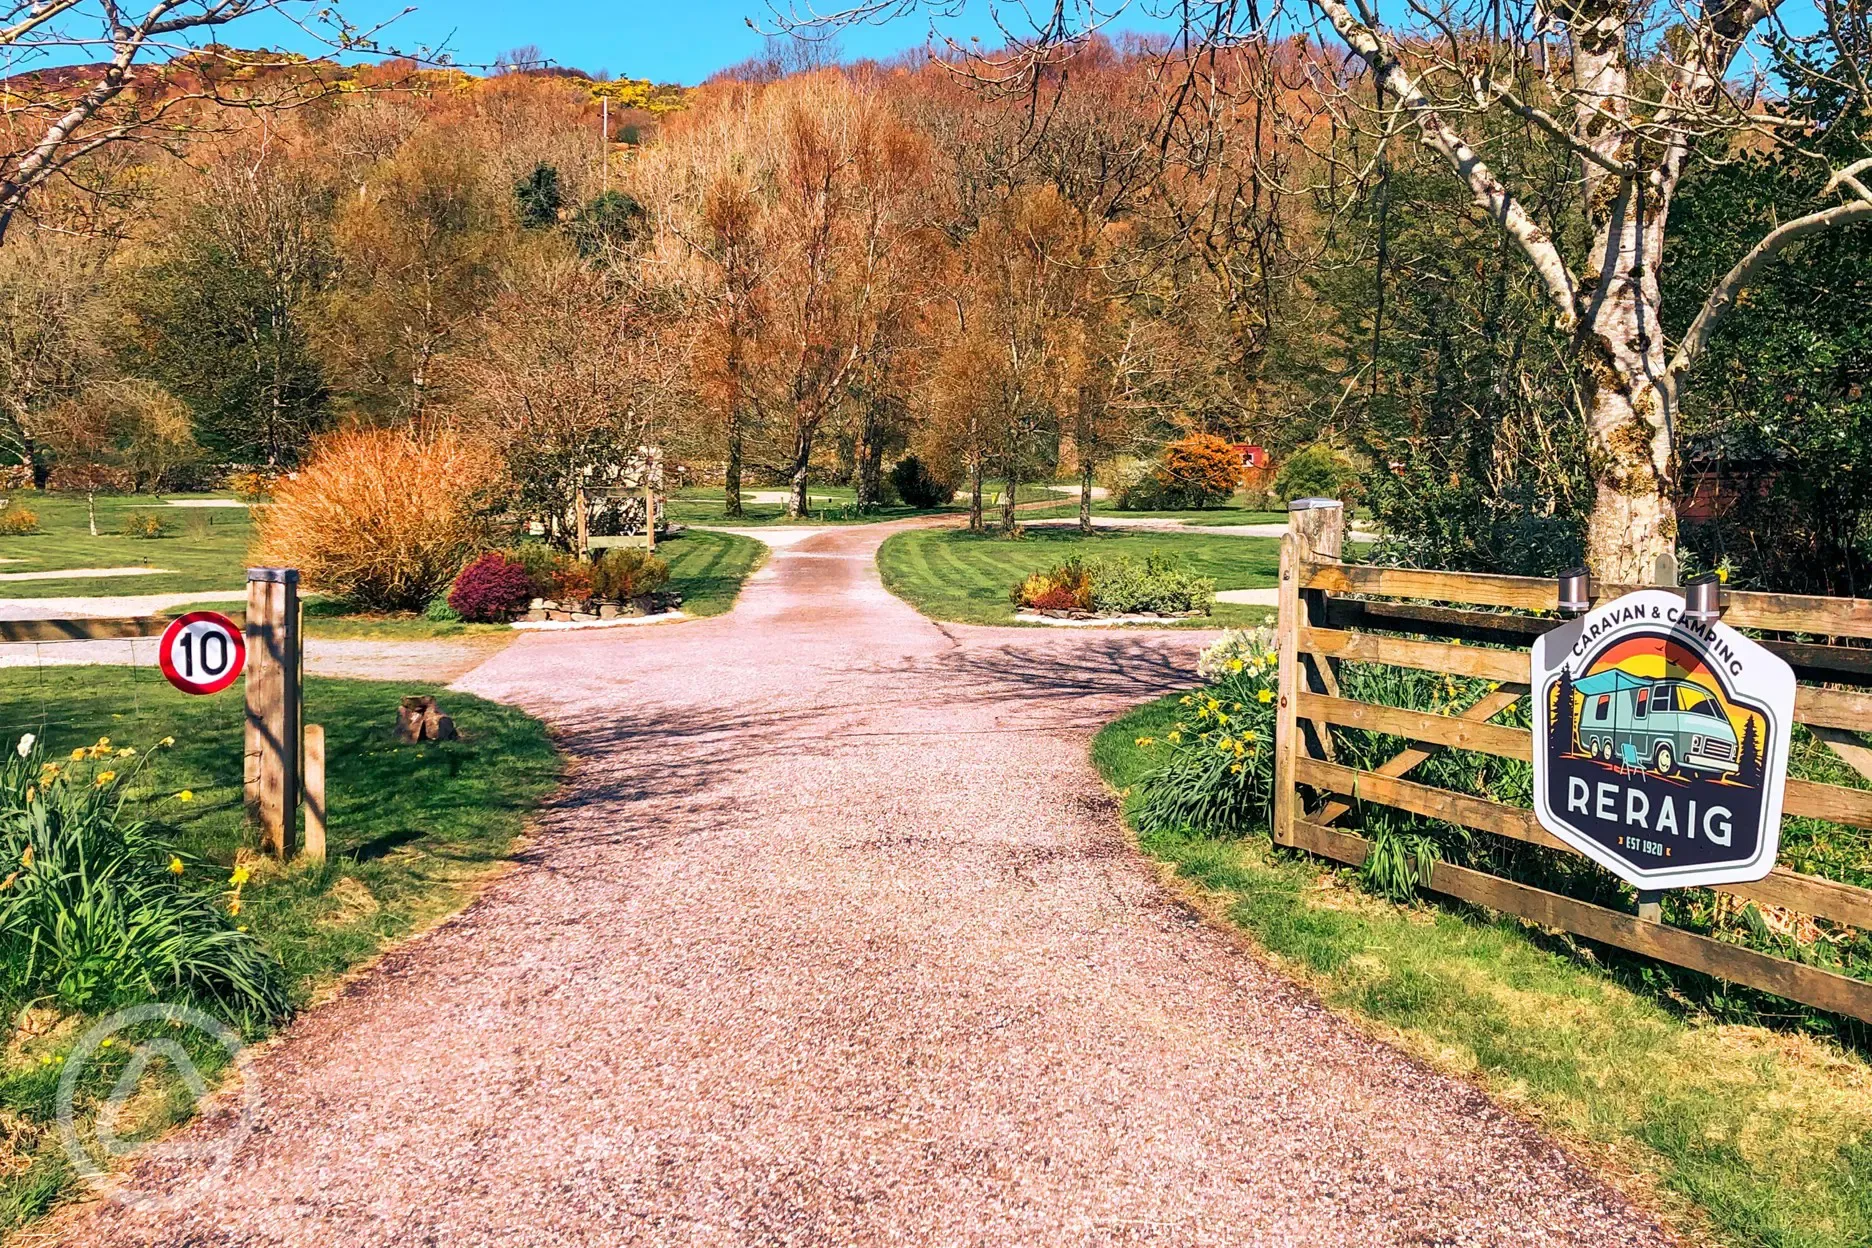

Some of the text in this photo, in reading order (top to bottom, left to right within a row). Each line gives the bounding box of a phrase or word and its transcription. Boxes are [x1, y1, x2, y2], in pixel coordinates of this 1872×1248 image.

[180, 631, 228, 677] 10
[1572, 604, 1743, 677] CARAVAN & CAMPING
[1567, 776, 1733, 847] RERAIG
[1626, 836, 1663, 856] EST 1920
